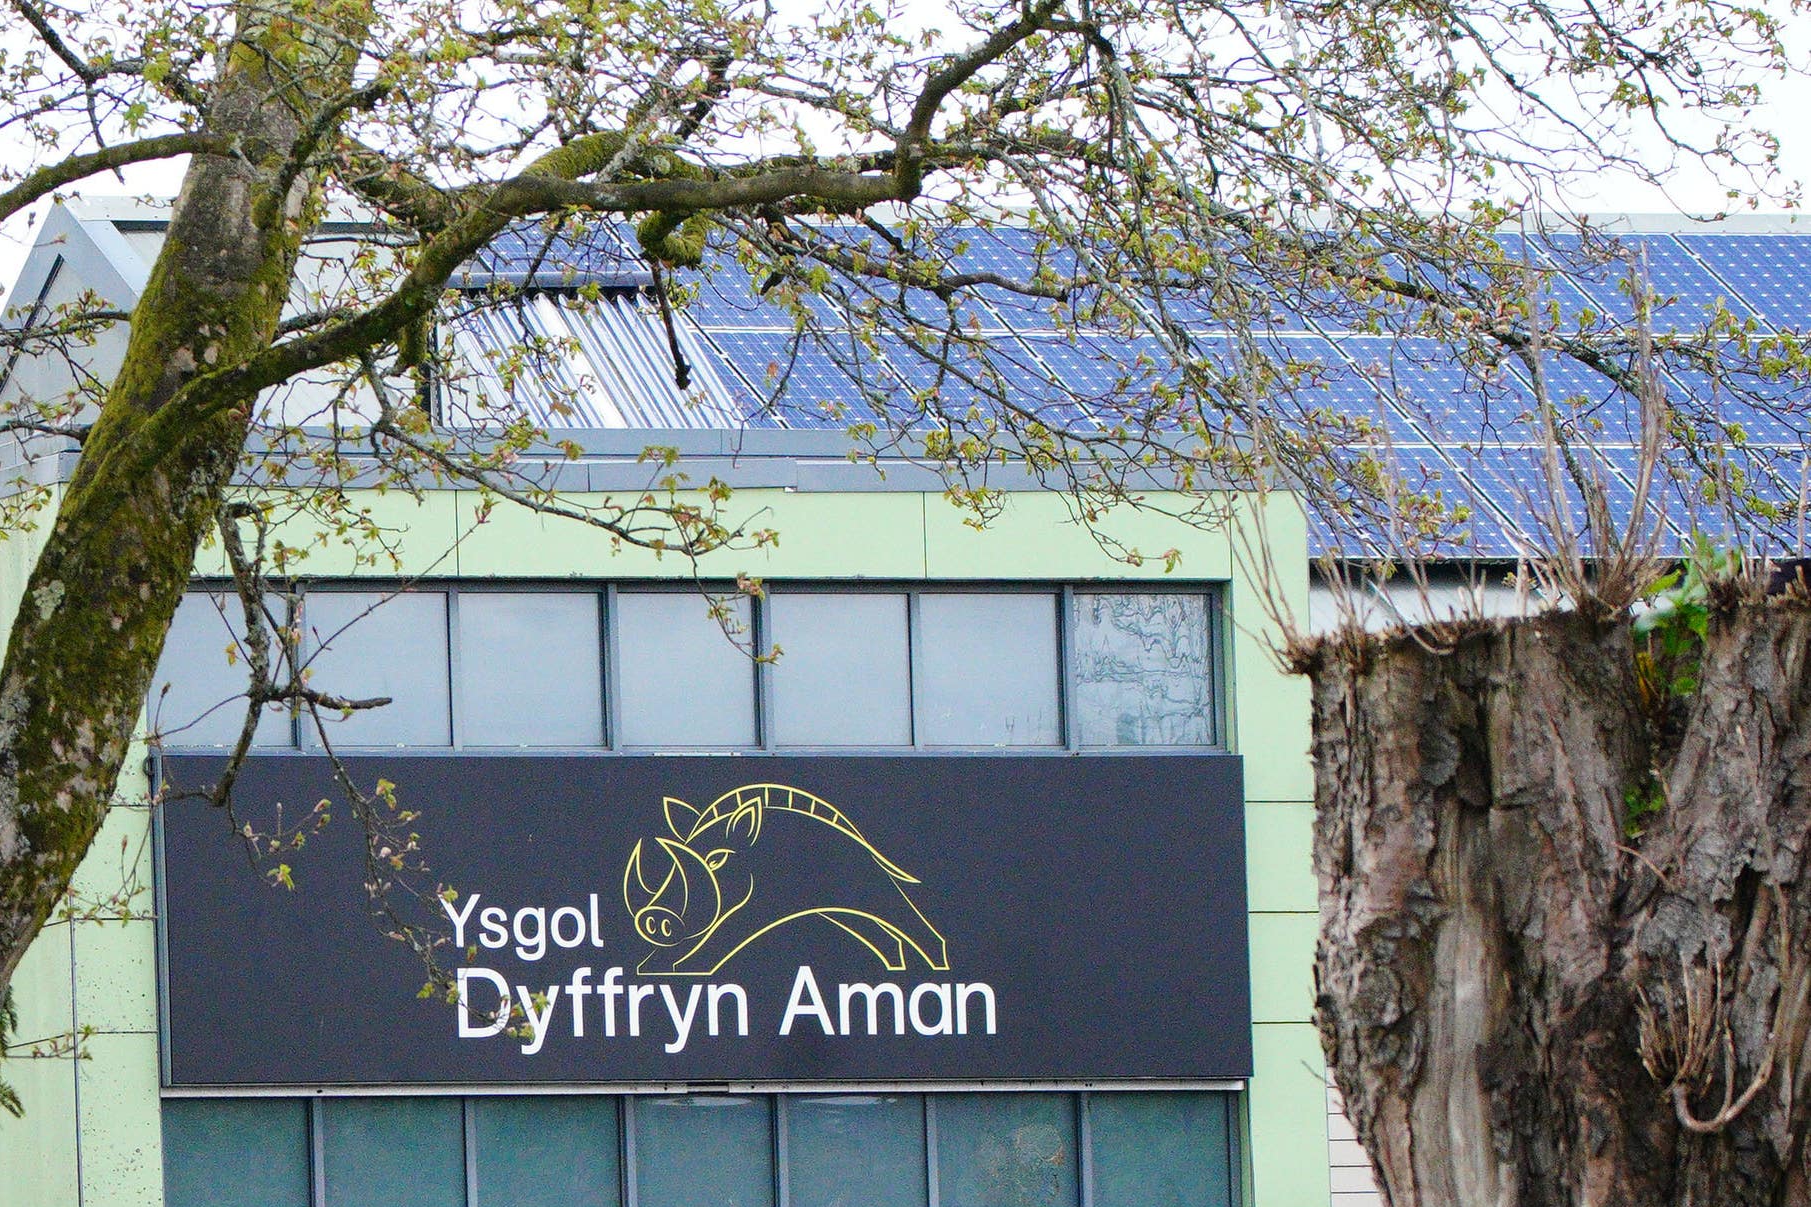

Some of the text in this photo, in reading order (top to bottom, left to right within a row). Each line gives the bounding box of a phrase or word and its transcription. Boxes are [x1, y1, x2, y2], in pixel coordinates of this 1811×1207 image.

[439, 893, 604, 961] Ysgol
[457, 965, 997, 1055] Dyffryn Aman
